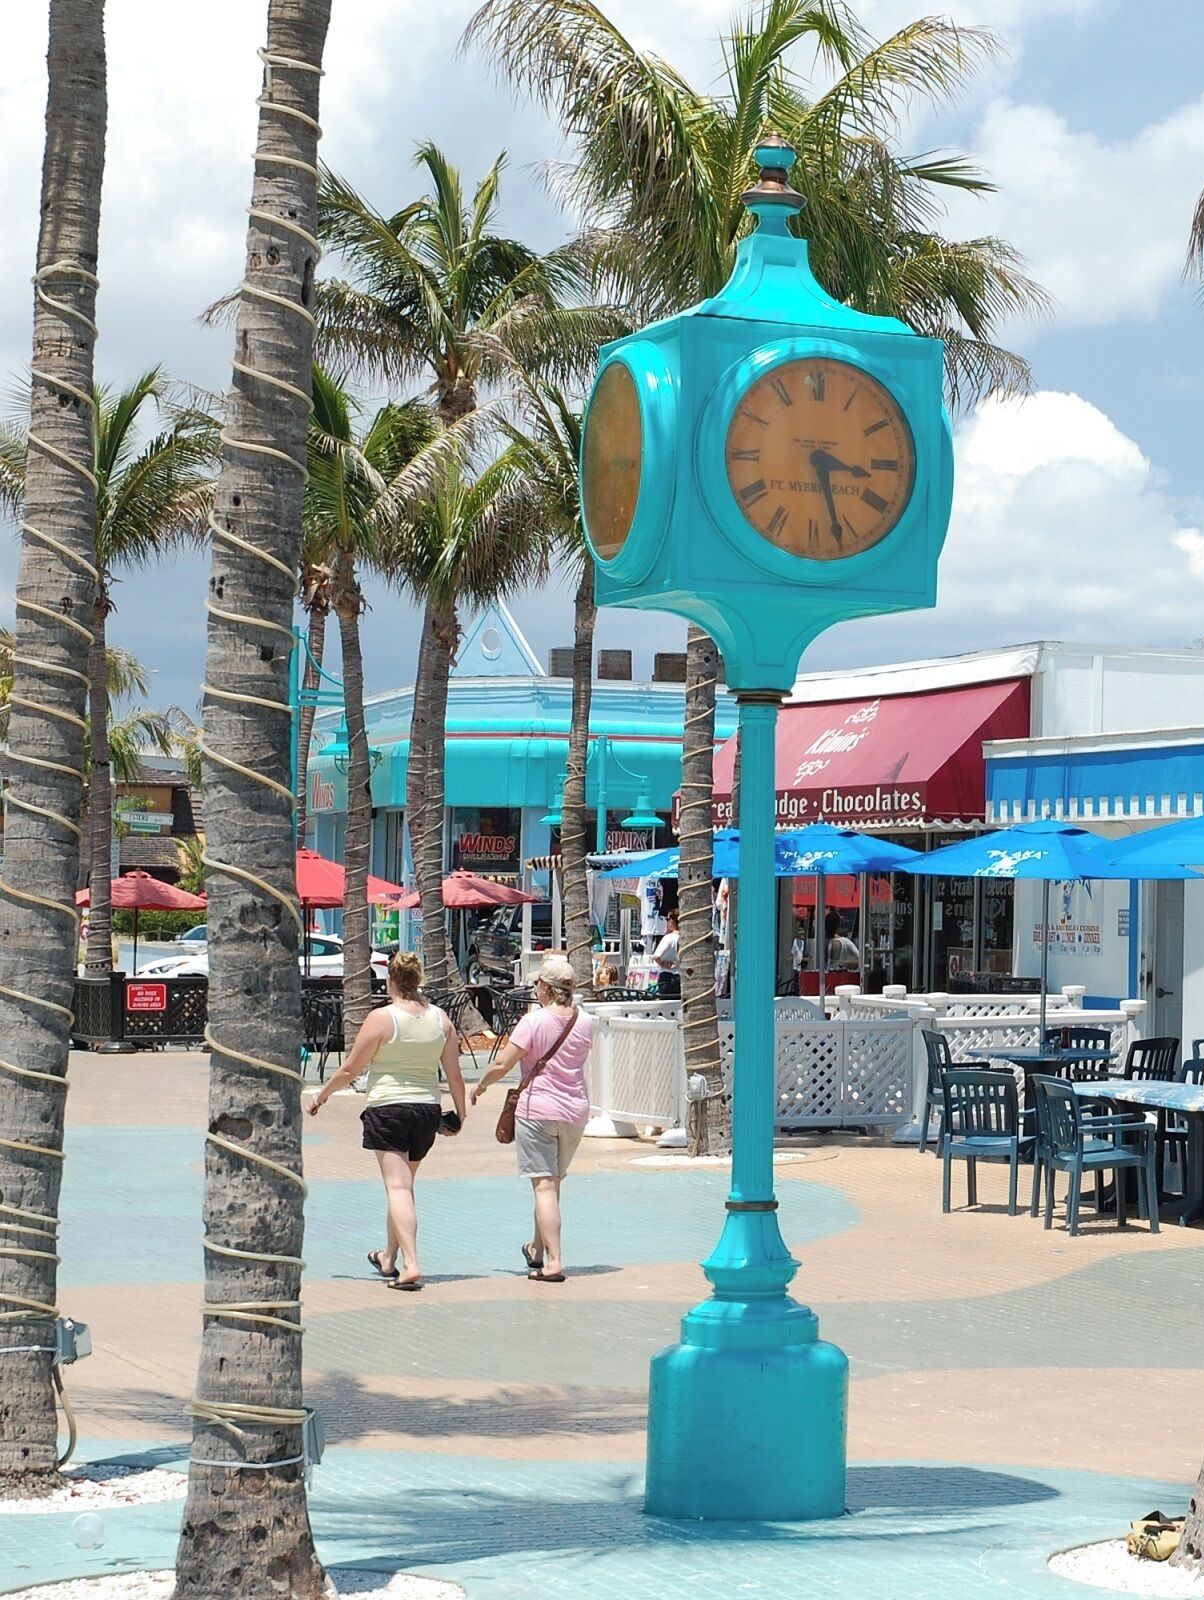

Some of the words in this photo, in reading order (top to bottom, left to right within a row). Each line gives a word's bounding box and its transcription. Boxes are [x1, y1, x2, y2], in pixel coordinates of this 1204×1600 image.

[789, 481, 821, 493] MYERS
[832, 484, 859, 496] EACH
[459, 832, 516, 853] WINDS
